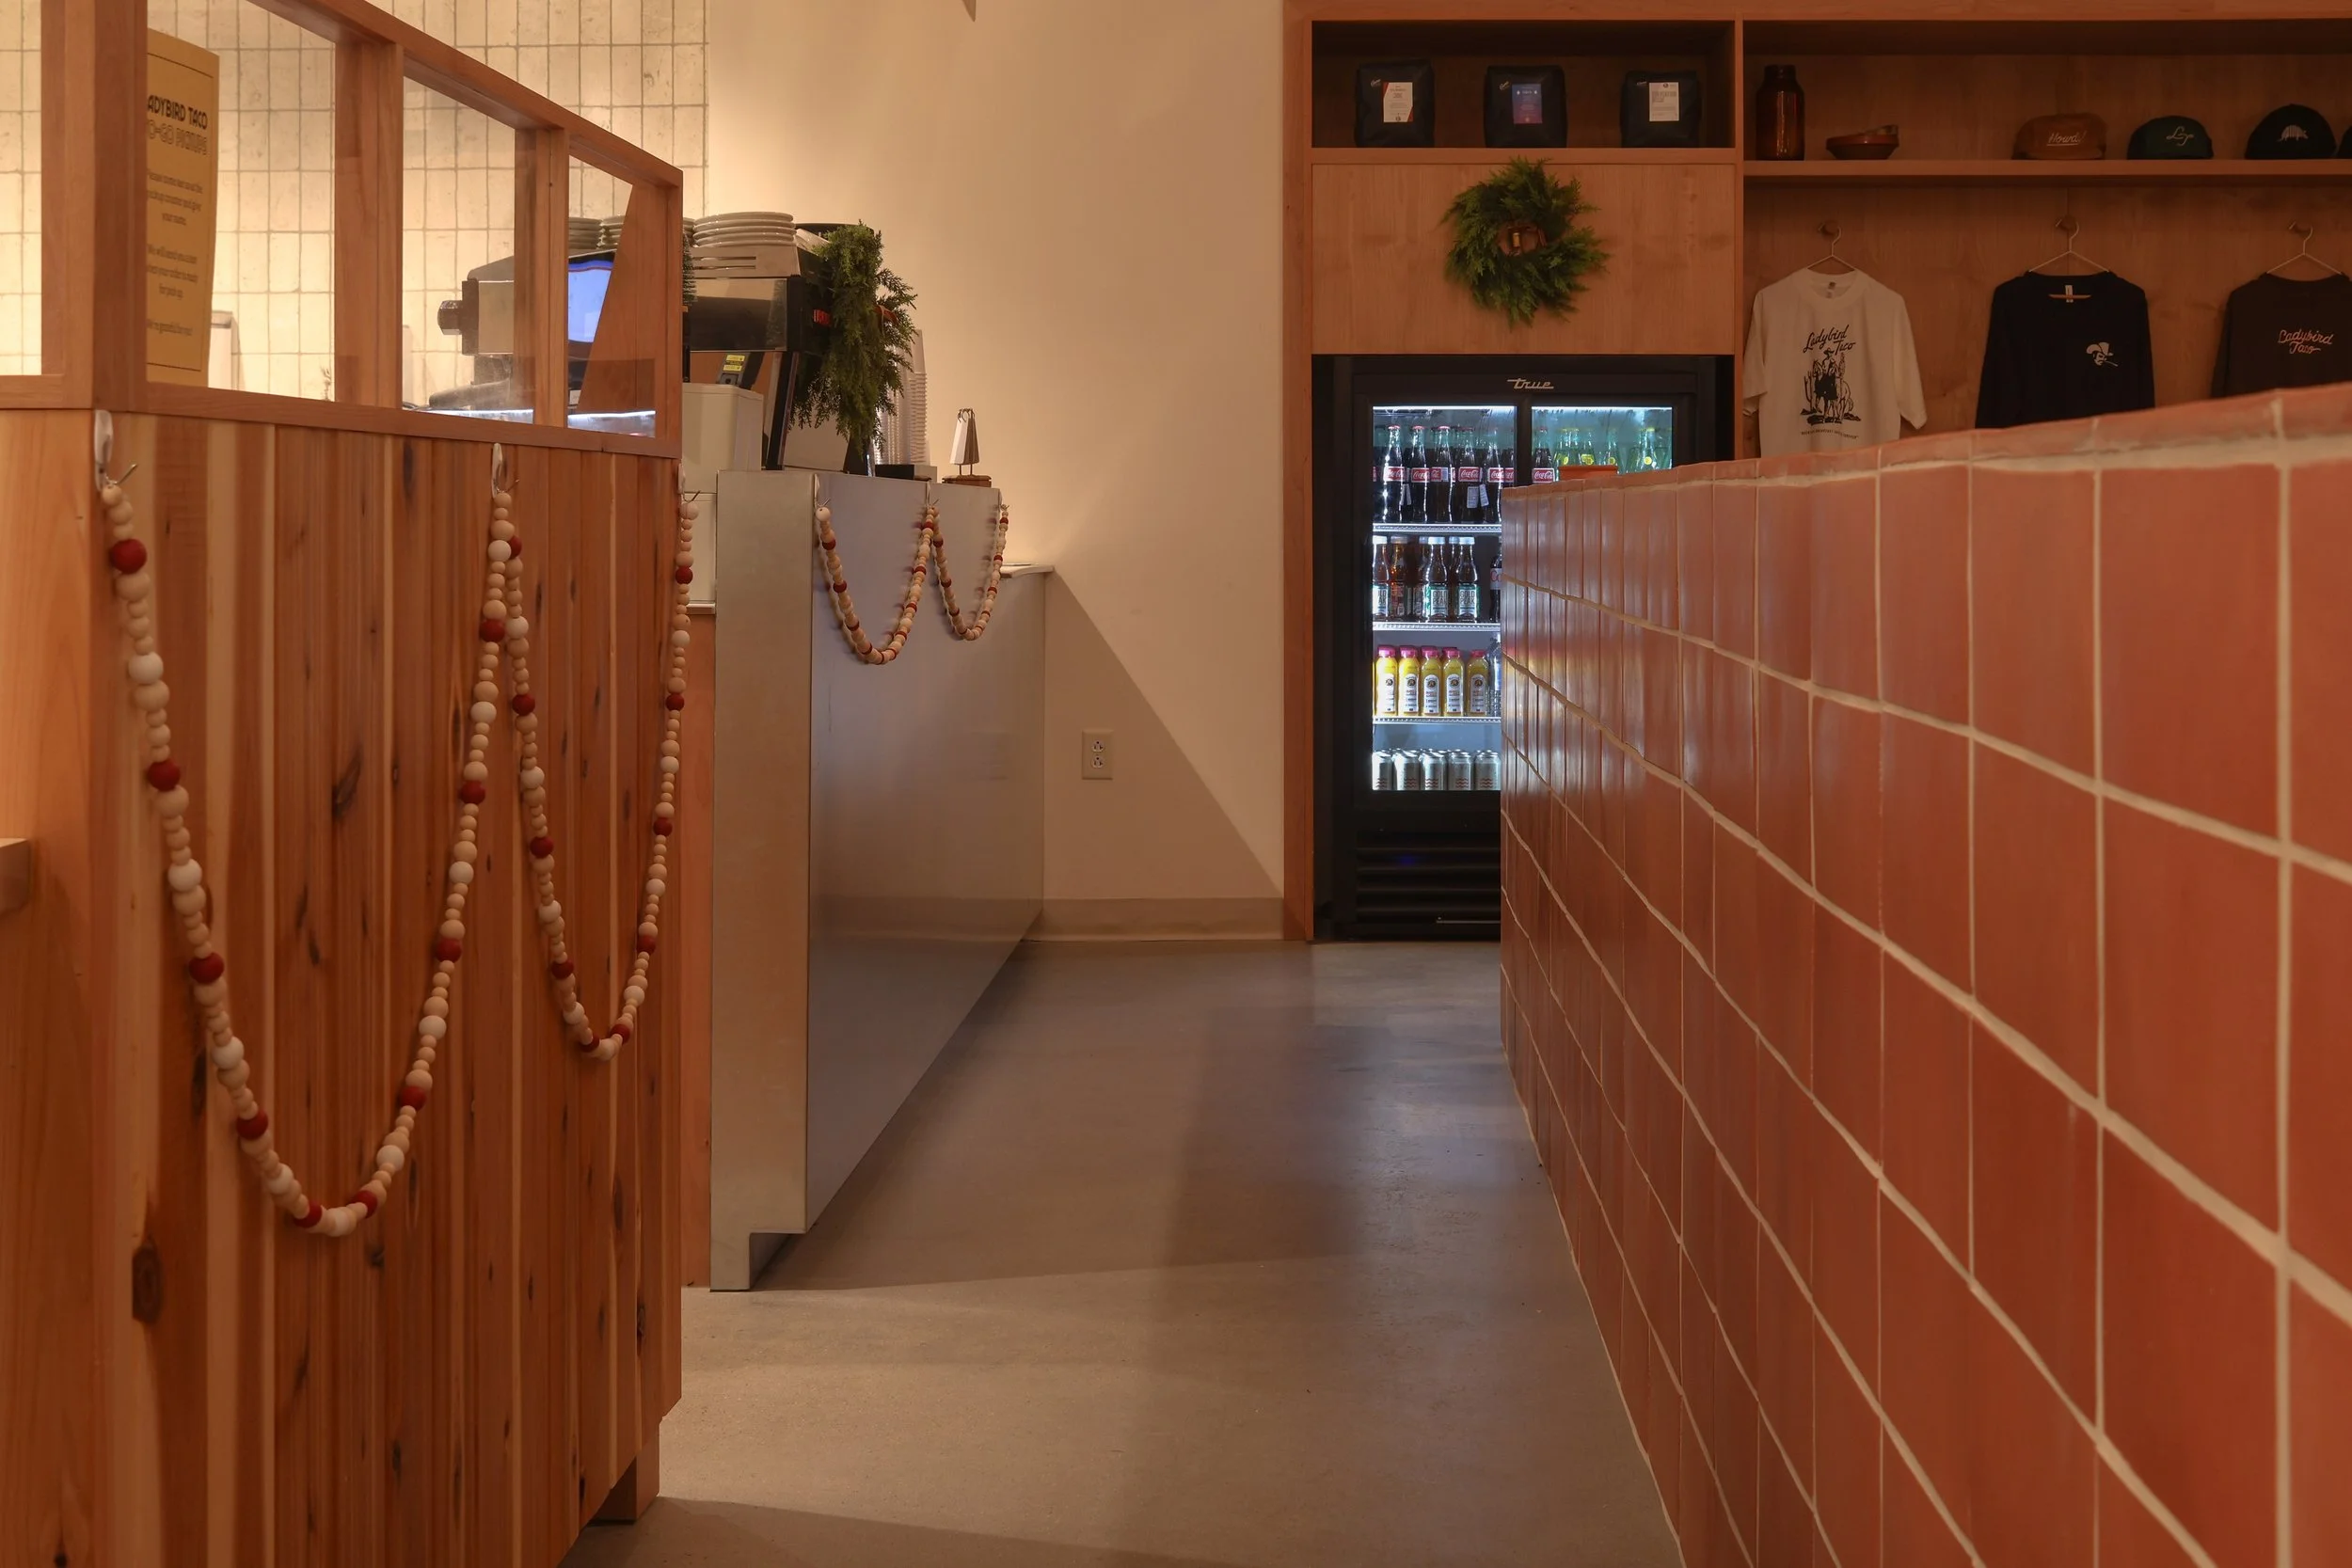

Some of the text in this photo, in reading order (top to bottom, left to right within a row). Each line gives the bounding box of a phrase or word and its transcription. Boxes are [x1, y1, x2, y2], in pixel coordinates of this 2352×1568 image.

[148, 95, 208, 130] ADYBIRD TACO
[1804, 325, 1850, 353] Ladybird
[2278, 328, 2334, 344] Ladybird
[1834, 340, 1856, 355] Taco
[2289, 341, 2322, 354] Taco
